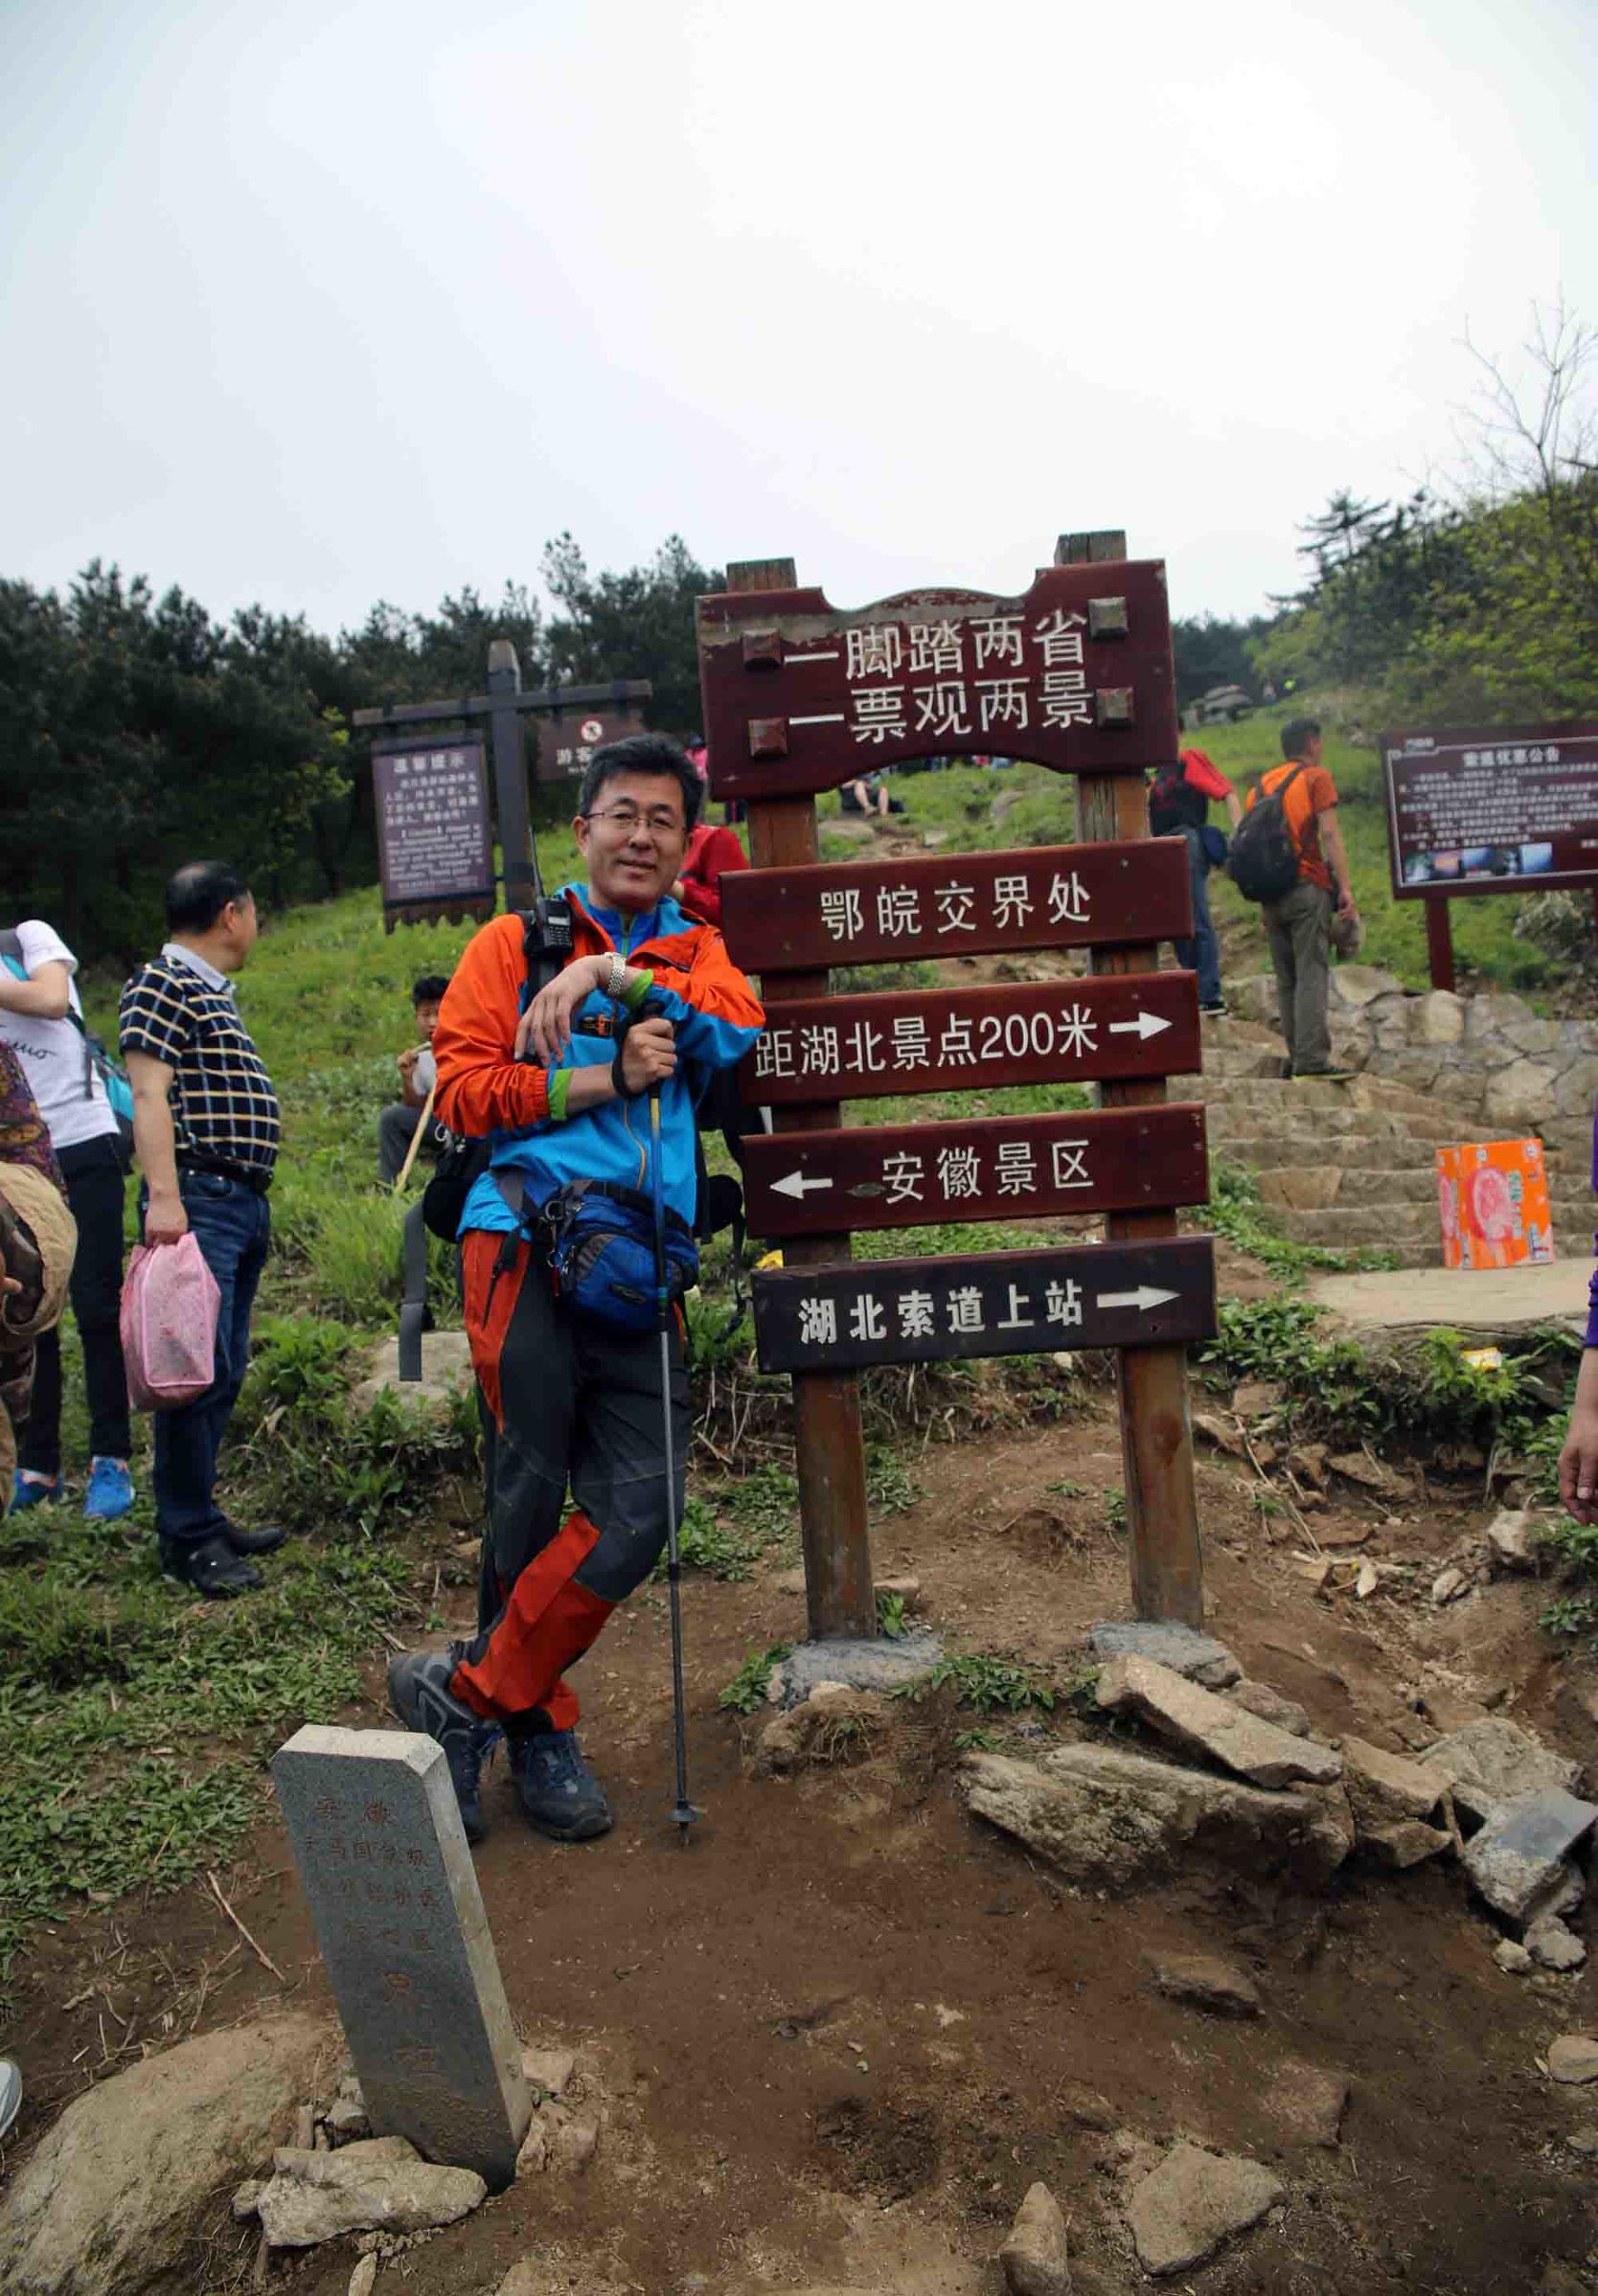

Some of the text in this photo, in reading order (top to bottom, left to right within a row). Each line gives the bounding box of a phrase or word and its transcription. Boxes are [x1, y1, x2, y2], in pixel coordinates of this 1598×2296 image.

[784, 607, 1087, 680] 一脚踏两省
[788, 670, 1094, 744] 一票观两景
[820, 871, 1091, 941] 鄂皖交界处
[755, 1003, 1098, 1078] 距湖北景点200米
[882, 1139, 1095, 1204] 安徽景区
[798, 1278, 1084, 1345] 湖北索道上站
